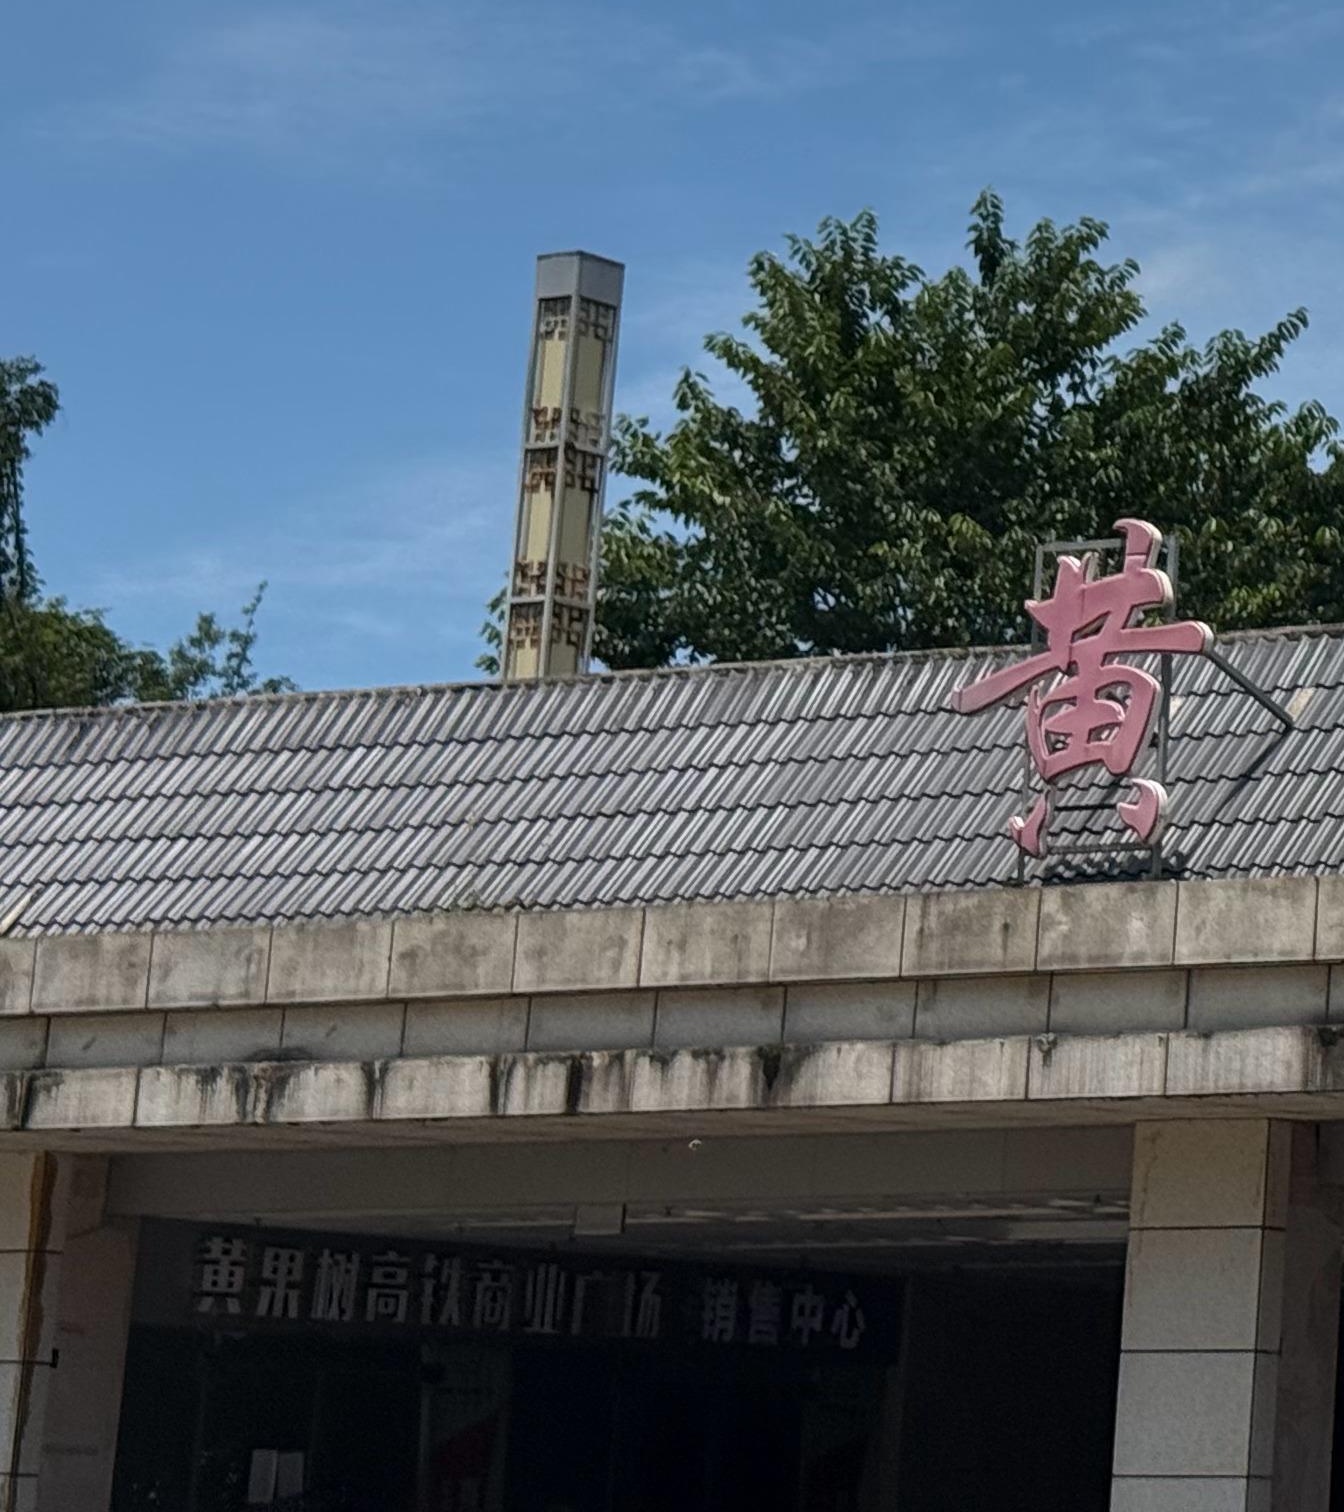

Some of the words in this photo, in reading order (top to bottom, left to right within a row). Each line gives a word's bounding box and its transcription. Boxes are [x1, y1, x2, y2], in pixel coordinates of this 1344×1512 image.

[197, 1236, 663, 1336] 黄果树高铁商业广场
[702, 1278, 866, 1349] 销售中心
